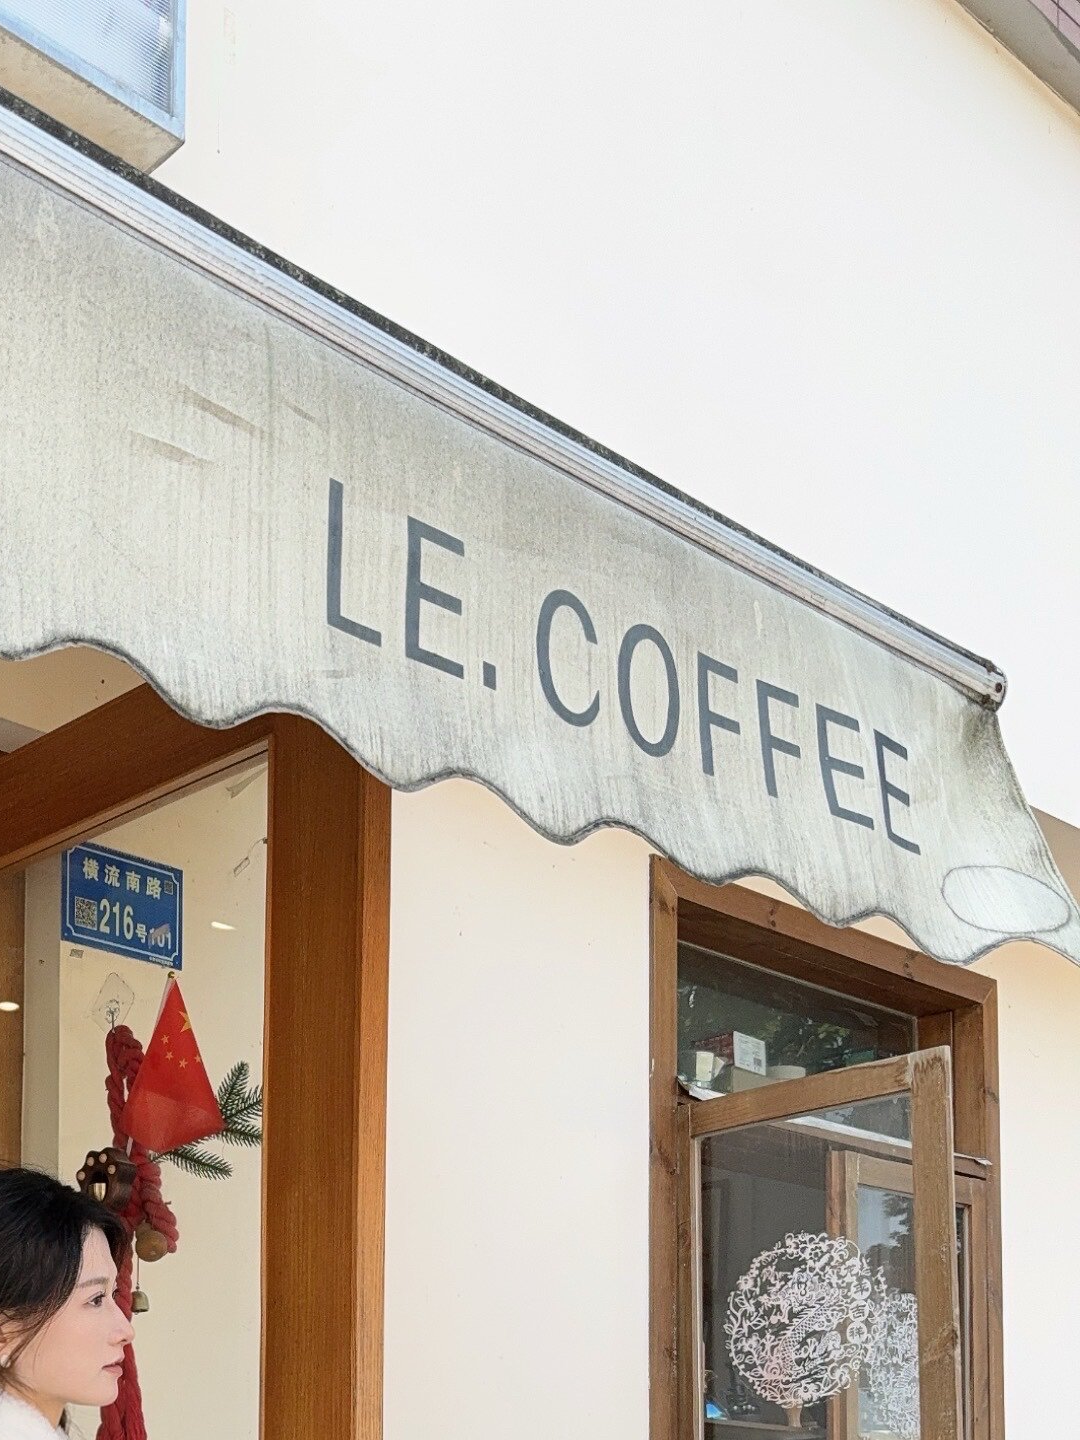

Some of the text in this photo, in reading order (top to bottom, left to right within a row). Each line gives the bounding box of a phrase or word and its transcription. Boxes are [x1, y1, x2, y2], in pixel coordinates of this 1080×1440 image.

[327, 478, 921, 855] LE. COFFEE
[82, 857, 162, 900] 横流南路
